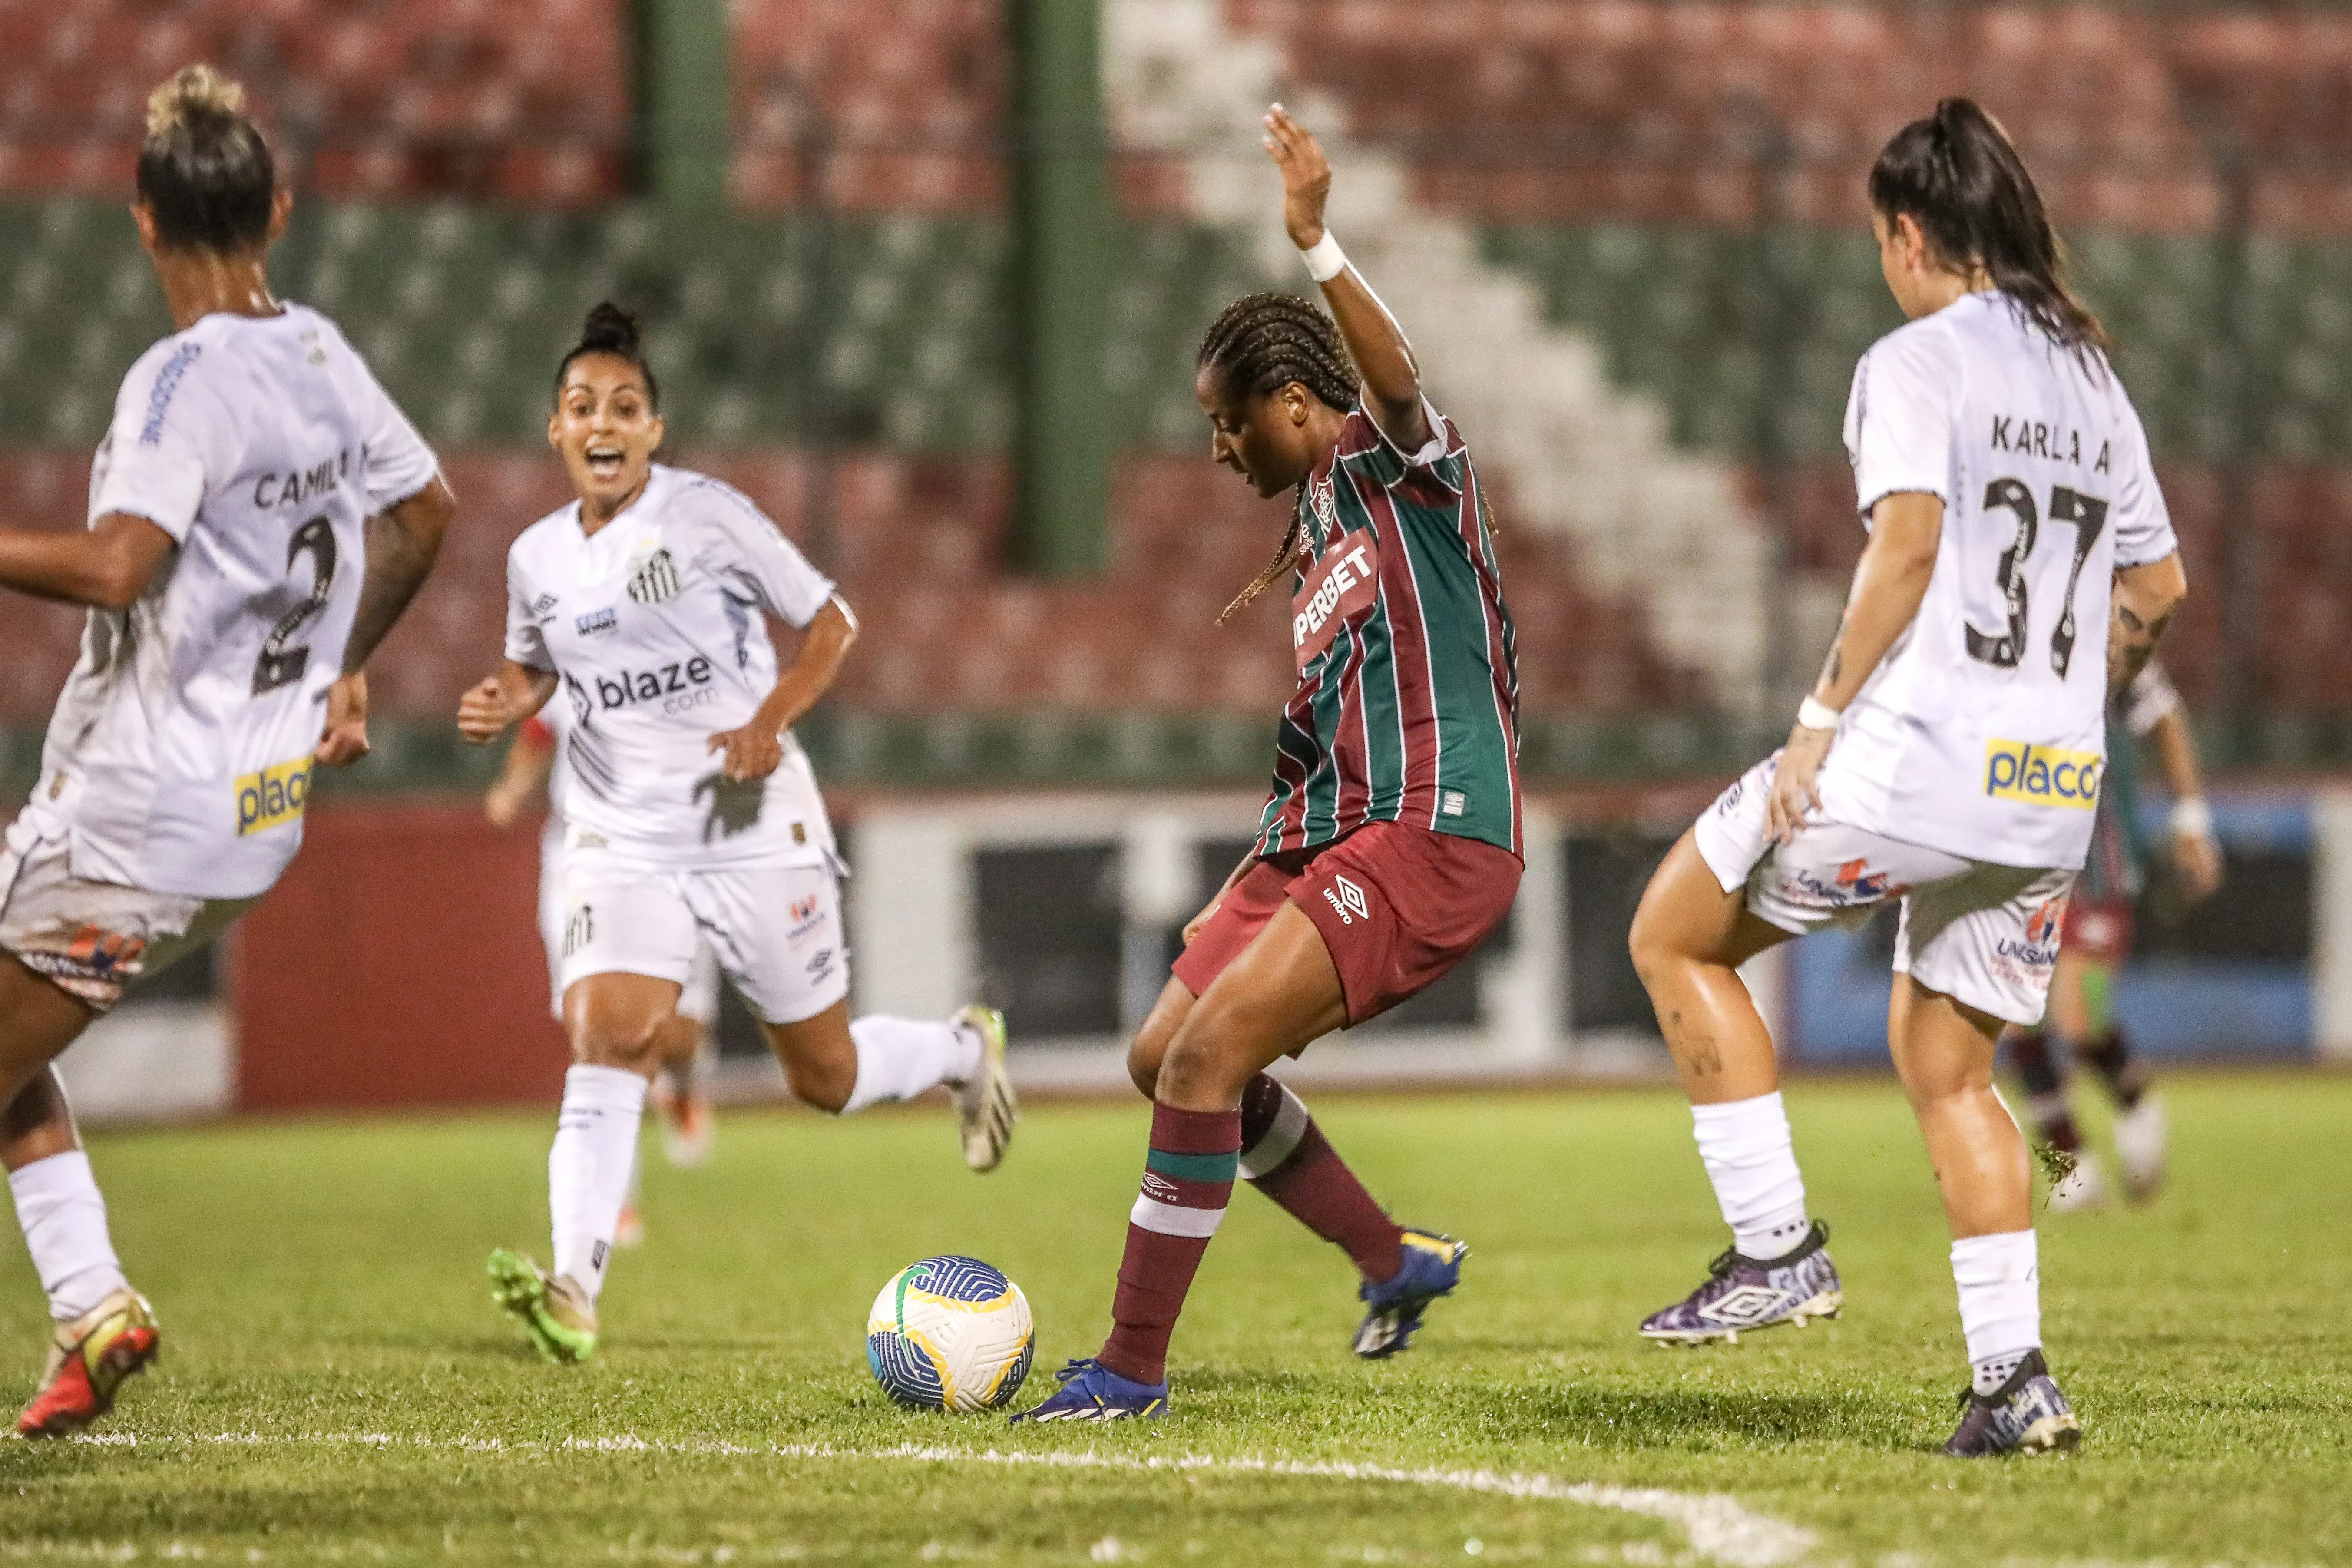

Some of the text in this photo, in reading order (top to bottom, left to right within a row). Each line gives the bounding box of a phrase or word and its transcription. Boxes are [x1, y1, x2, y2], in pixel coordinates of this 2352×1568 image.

[1991, 414, 2110, 475] KARLA A
[251, 514, 336, 698] 2
[1293, 545, 1371, 650] PERBET
[1964, 478, 2109, 681] 37
[595, 658, 710, 710] blaze
[663, 687, 718, 715] com
[1987, 744, 2097, 799] placo
[1323, 887, 1352, 925] umbro
